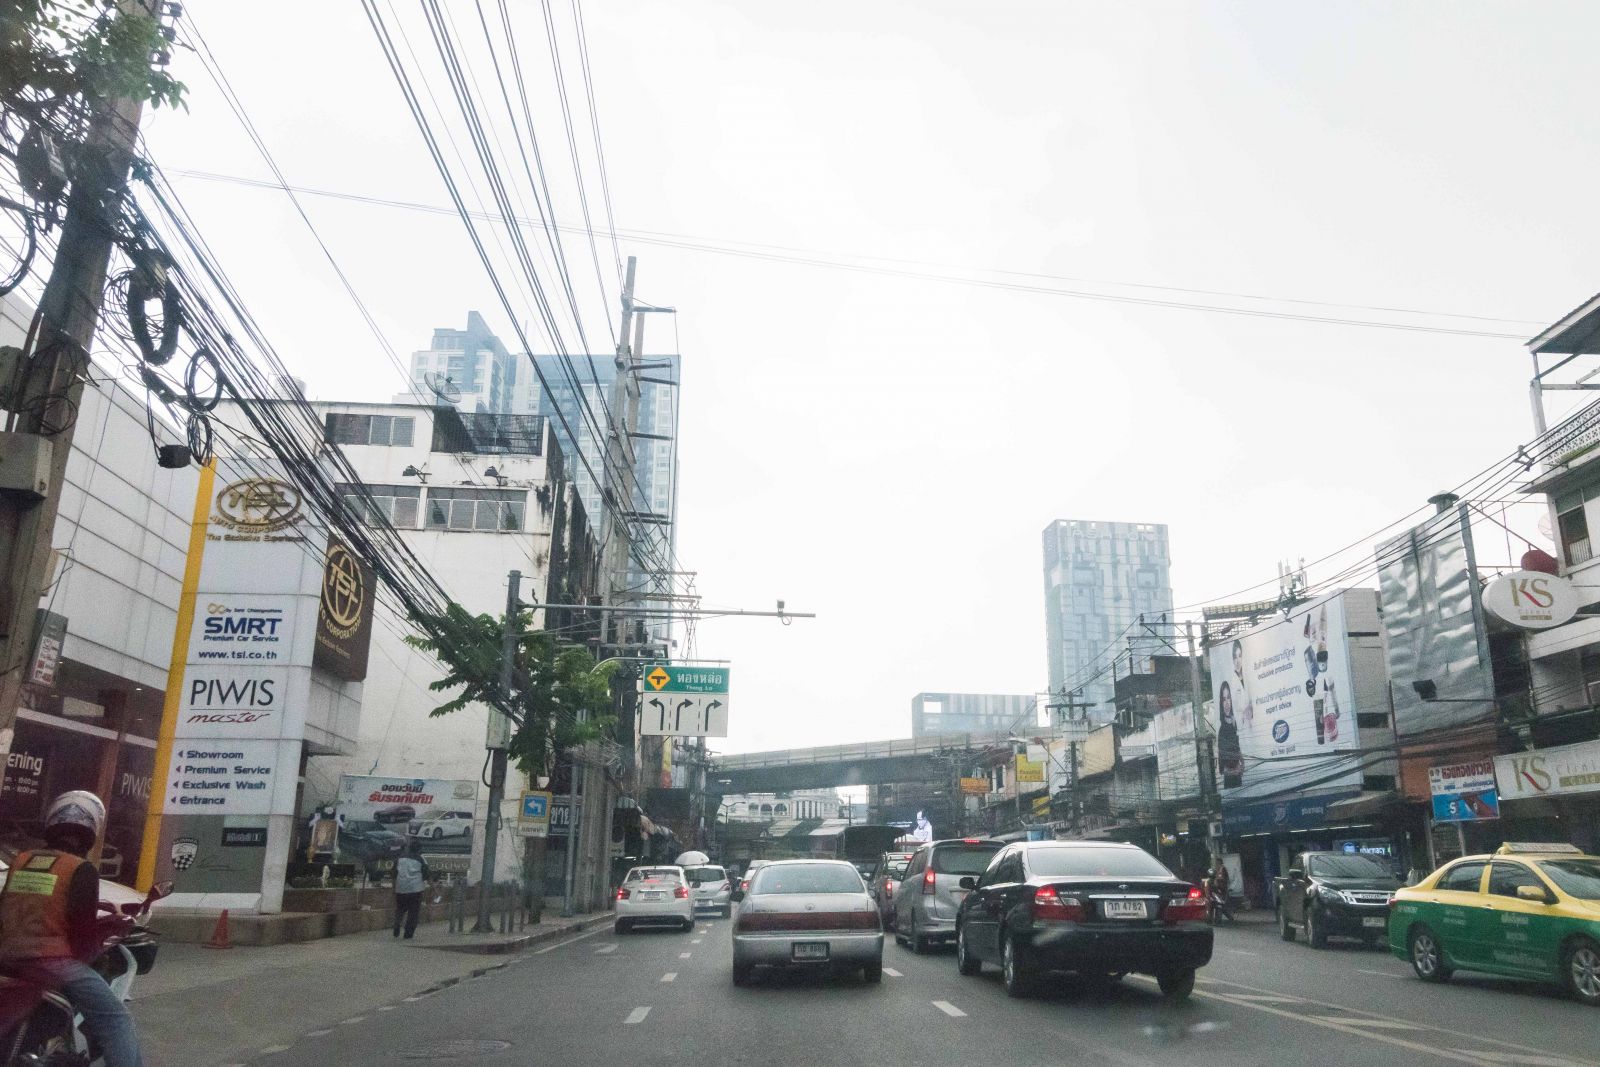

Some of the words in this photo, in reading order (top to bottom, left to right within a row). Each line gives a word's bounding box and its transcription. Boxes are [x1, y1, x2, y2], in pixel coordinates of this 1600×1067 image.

[1510, 577, 1553, 609] KS
[204, 616, 283, 635] SMRT
[326, 616, 361, 640] CORPORATION
[203, 634, 235, 642] Premium
[236, 634, 250, 642] Car
[252, 634, 280, 642] Service
[676, 671, 722, 684] ทองหล่อ
[189, 678, 275, 706] PIWIS
[186, 711, 271, 724] master
[186, 750, 245, 760] Showroom
[184, 765, 228, 775] Premium
[233, 765, 272, 775] Service
[1511, 755, 1552, 792] KS
[182, 780, 231, 790] Exclusive
[235, 780, 267, 790] Wash
[179, 795, 226, 805] Entrance
